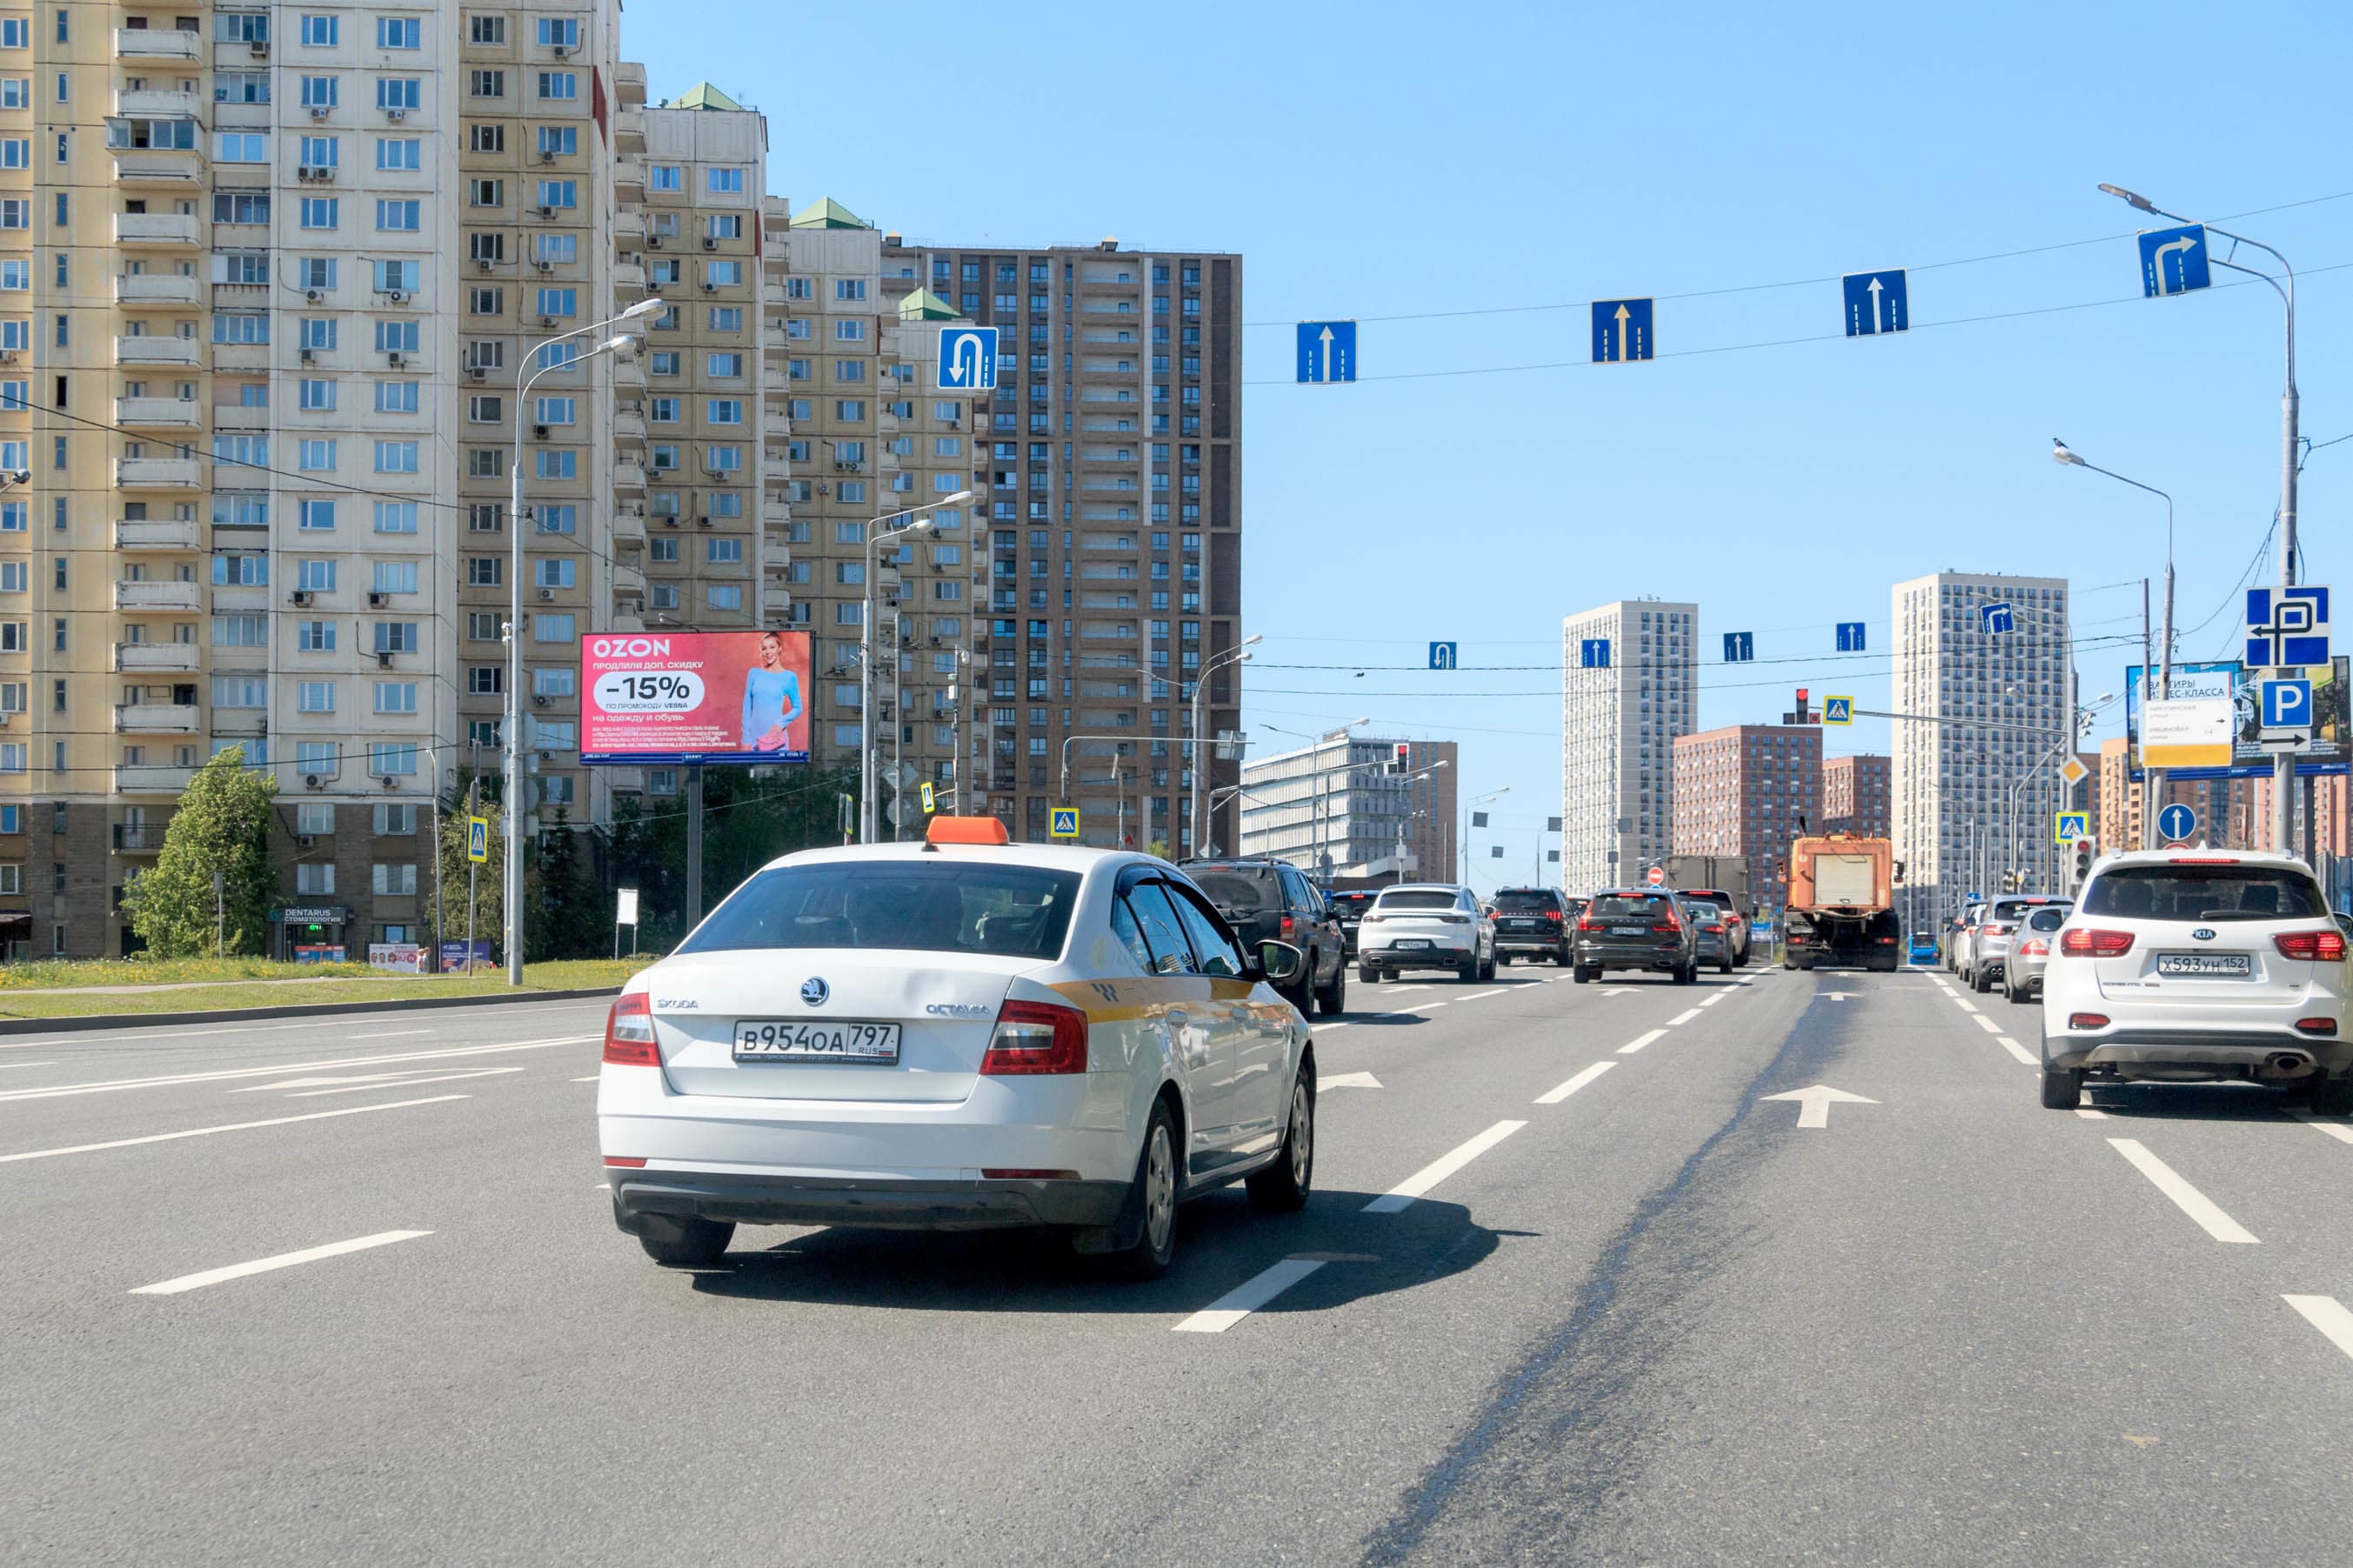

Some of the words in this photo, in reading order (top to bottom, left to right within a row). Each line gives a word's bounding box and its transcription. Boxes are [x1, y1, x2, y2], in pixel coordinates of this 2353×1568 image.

[593, 639, 670, 657] OZON
[667, 661, 704, 670] СКИДКУ
[606, 677, 690, 699] -15%
[2276, 685, 2303, 722] P
[654, 713, 685, 723] обувь
[2195, 930, 2214, 938] KIA
[2223, 957, 2245, 968] 152
[926, 1004, 989, 1016] OCTAVIA
[851, 1025, 892, 1046] 797
[858, 1047, 878, 1056] RUS
